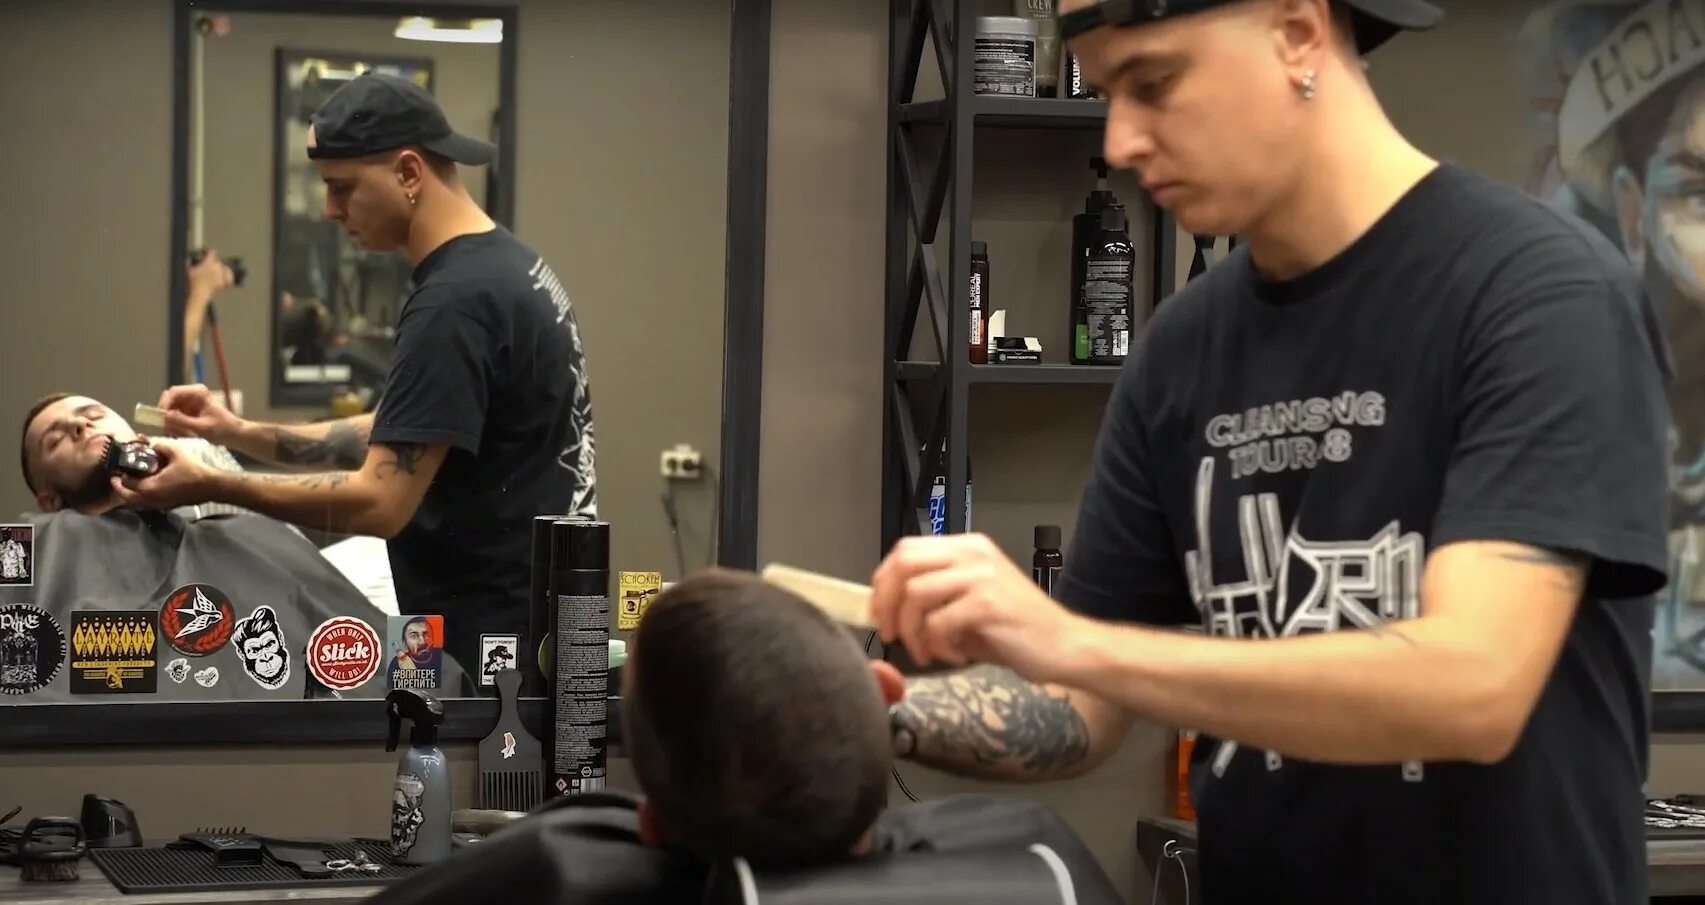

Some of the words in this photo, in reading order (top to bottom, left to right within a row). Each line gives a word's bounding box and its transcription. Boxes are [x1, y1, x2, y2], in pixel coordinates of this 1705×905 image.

[76, 632, 153, 645] LAYRITE
[326, 628, 346, 641] WHEN
[347, 628, 365, 641] ONLY
[320, 641, 370, 663] Slick
[329, 668, 345, 680] WILL
[392, 669, 436, 679] #ВПИТЕРЕ
